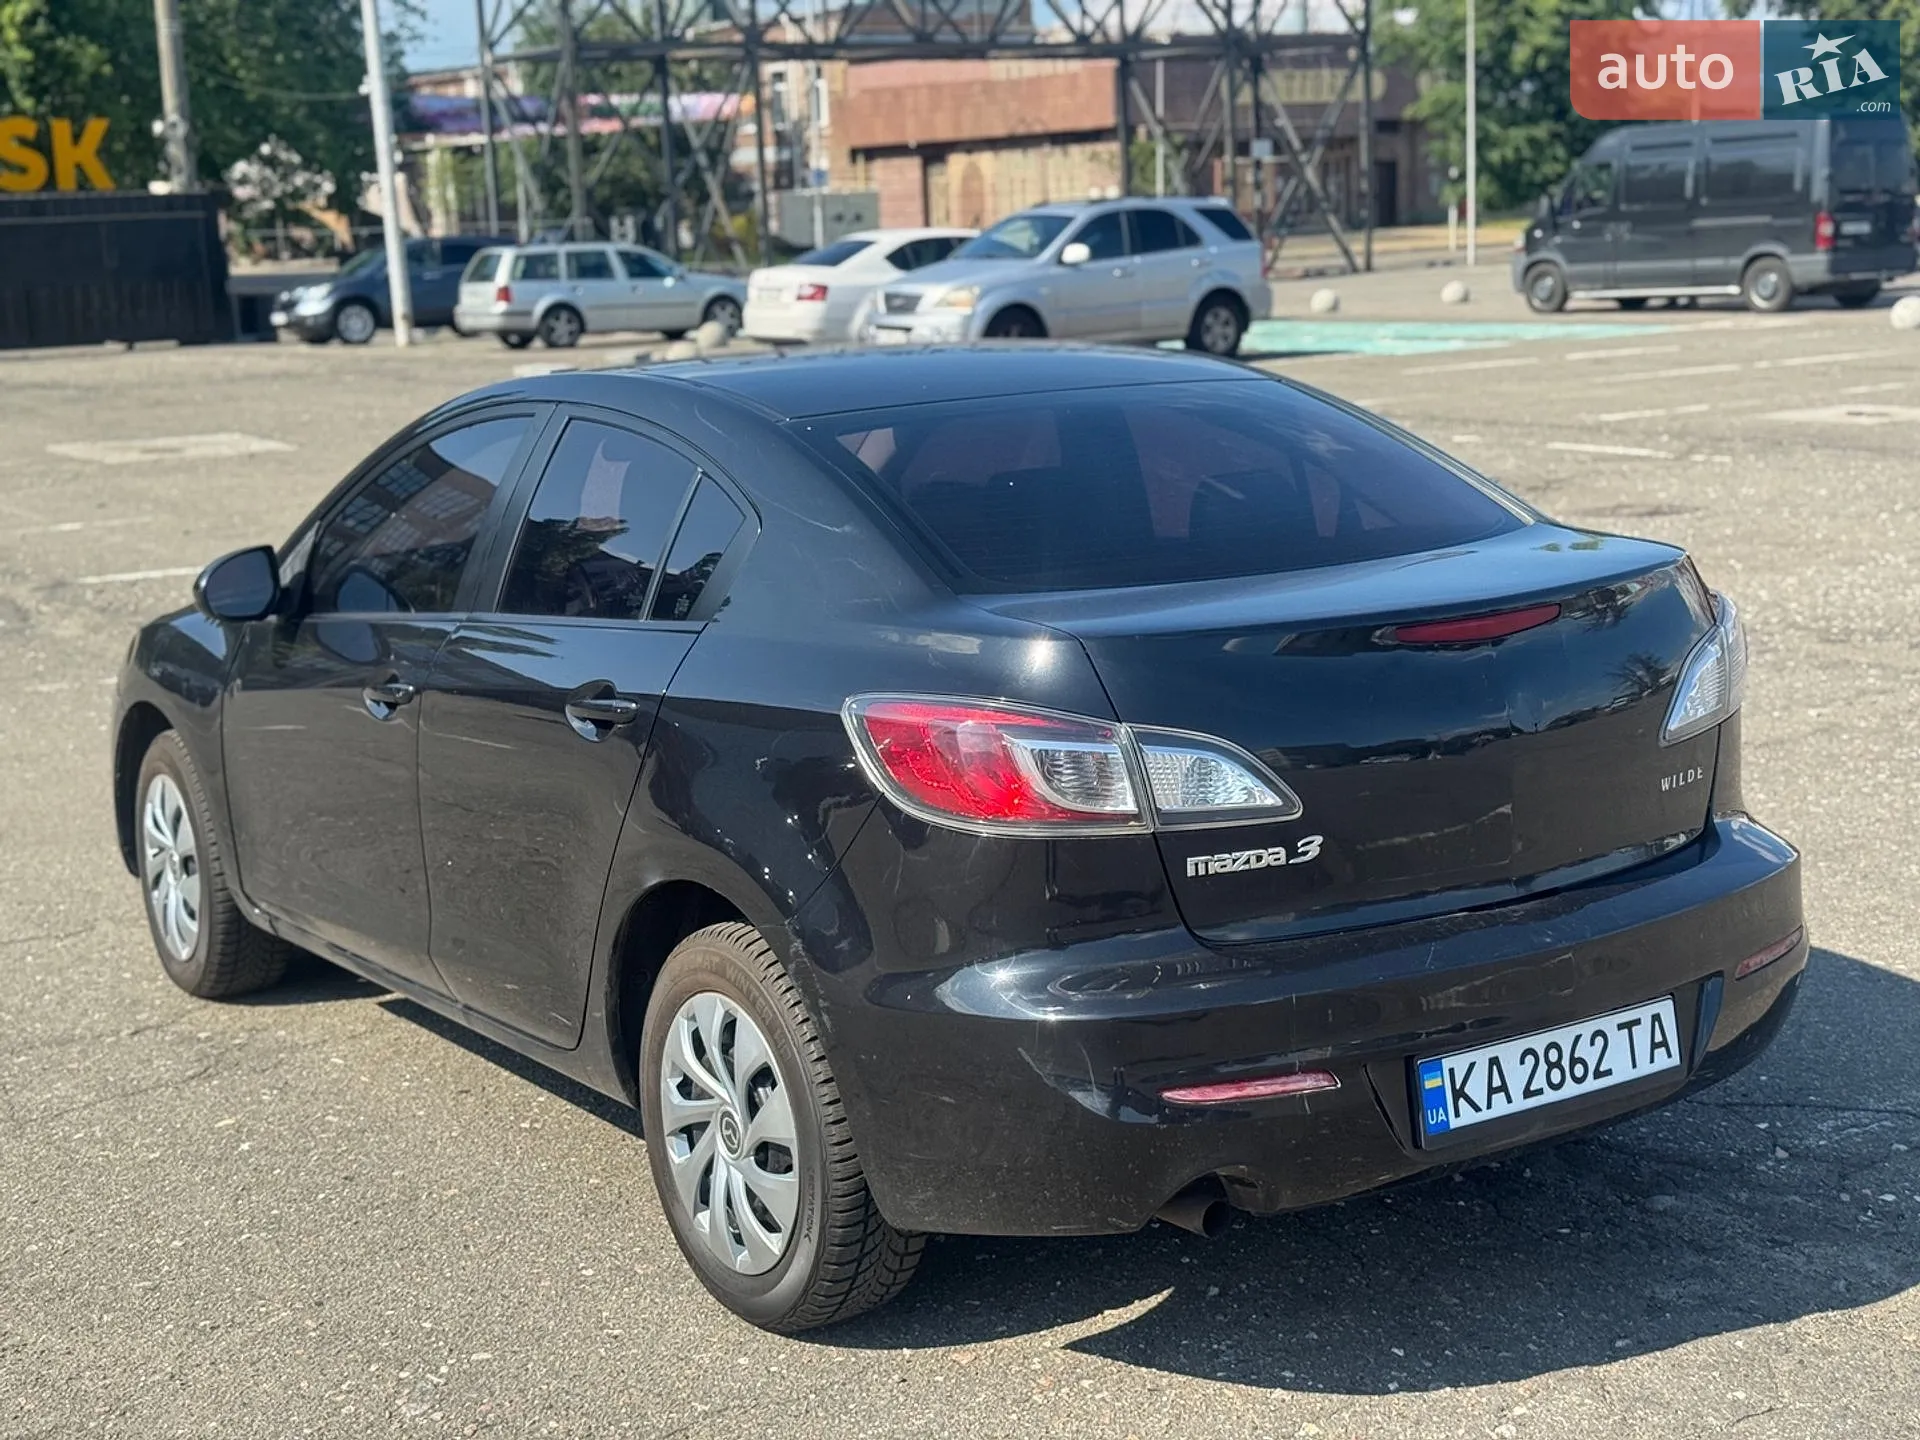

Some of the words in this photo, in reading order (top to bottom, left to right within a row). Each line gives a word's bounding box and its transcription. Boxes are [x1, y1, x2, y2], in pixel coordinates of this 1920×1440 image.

[0, 115, 116, 192] SK
[1661, 766, 1704, 791] WILDE
[1288, 835, 1324, 864] 3
[1427, 1106, 1448, 1125] UA
